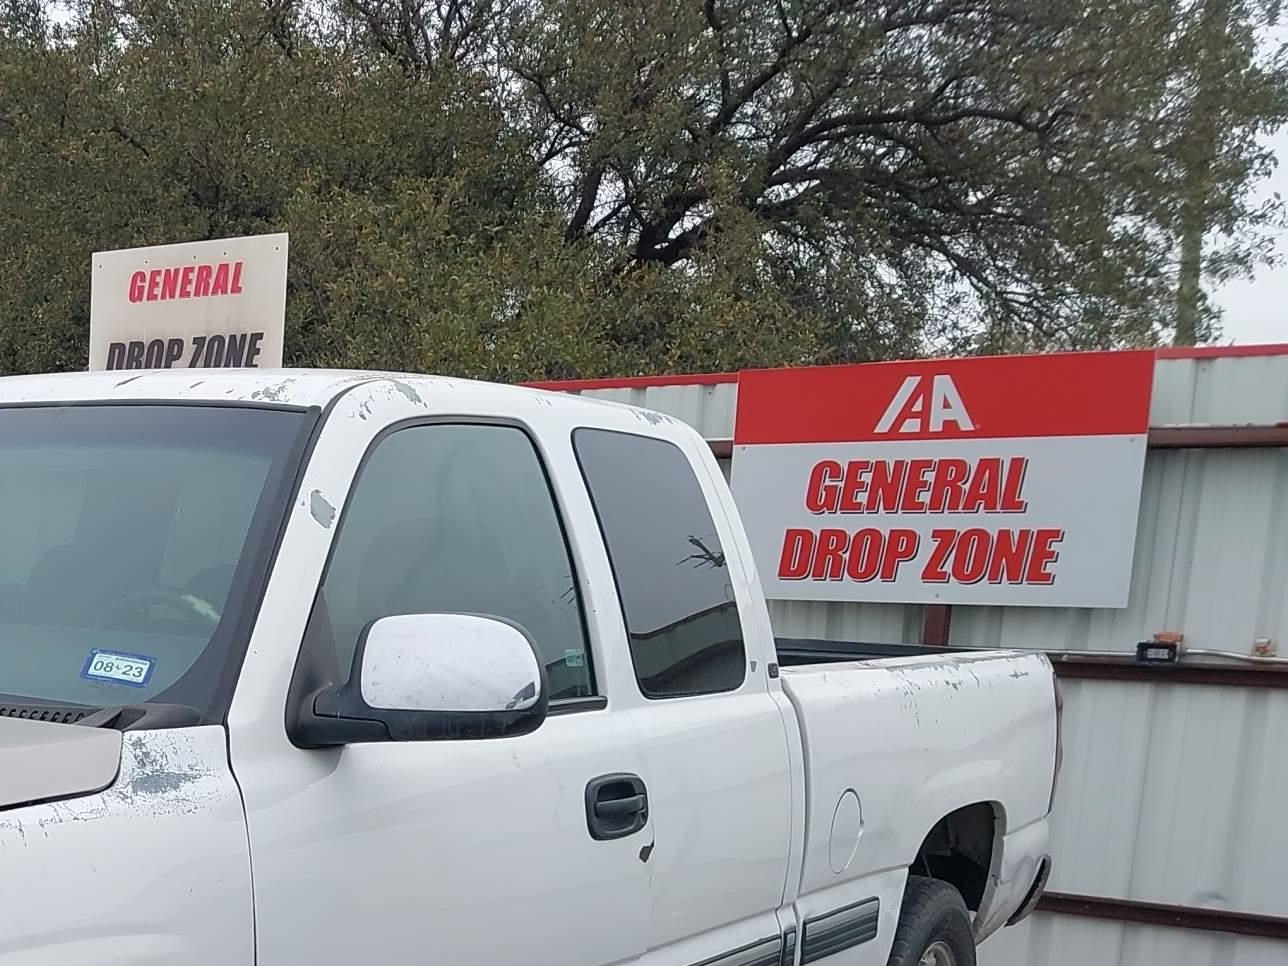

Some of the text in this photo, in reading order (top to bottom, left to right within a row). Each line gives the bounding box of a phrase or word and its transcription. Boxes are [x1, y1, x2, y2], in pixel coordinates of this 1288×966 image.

[128, 261, 244, 303] GENERAL
[106, 332, 264, 370] DROP ZONE
[804, 456, 1030, 515] GENERAL
[777, 527, 1065, 586] DROP ZONE
